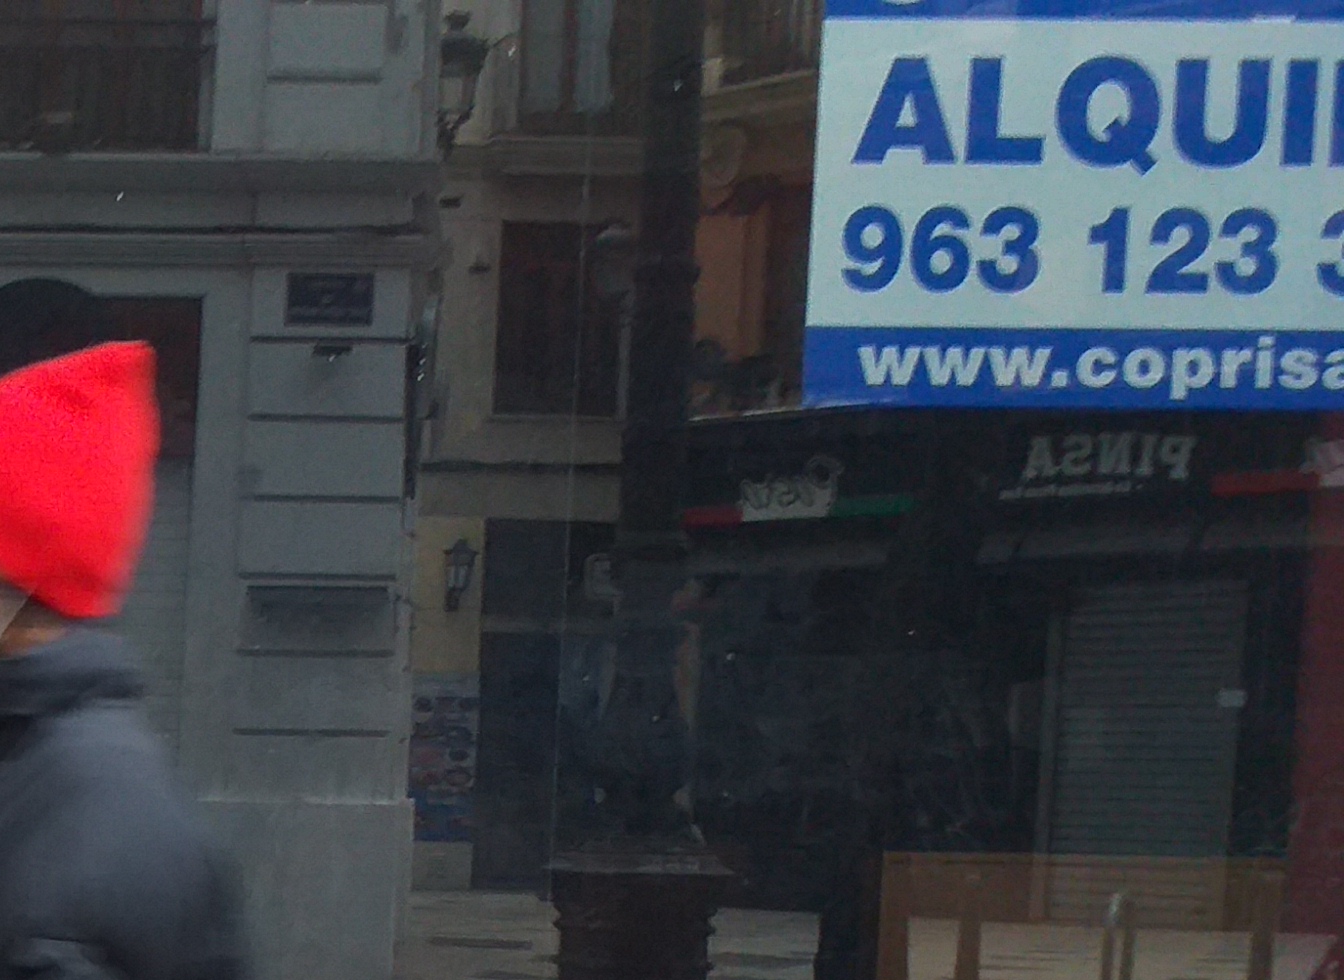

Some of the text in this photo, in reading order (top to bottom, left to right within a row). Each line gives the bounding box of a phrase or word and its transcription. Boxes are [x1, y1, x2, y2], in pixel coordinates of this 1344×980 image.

[852, 55, 1344, 177] ALQUI
[839, 202, 1041, 294] 963
[1089, 206, 1279, 296] 123
